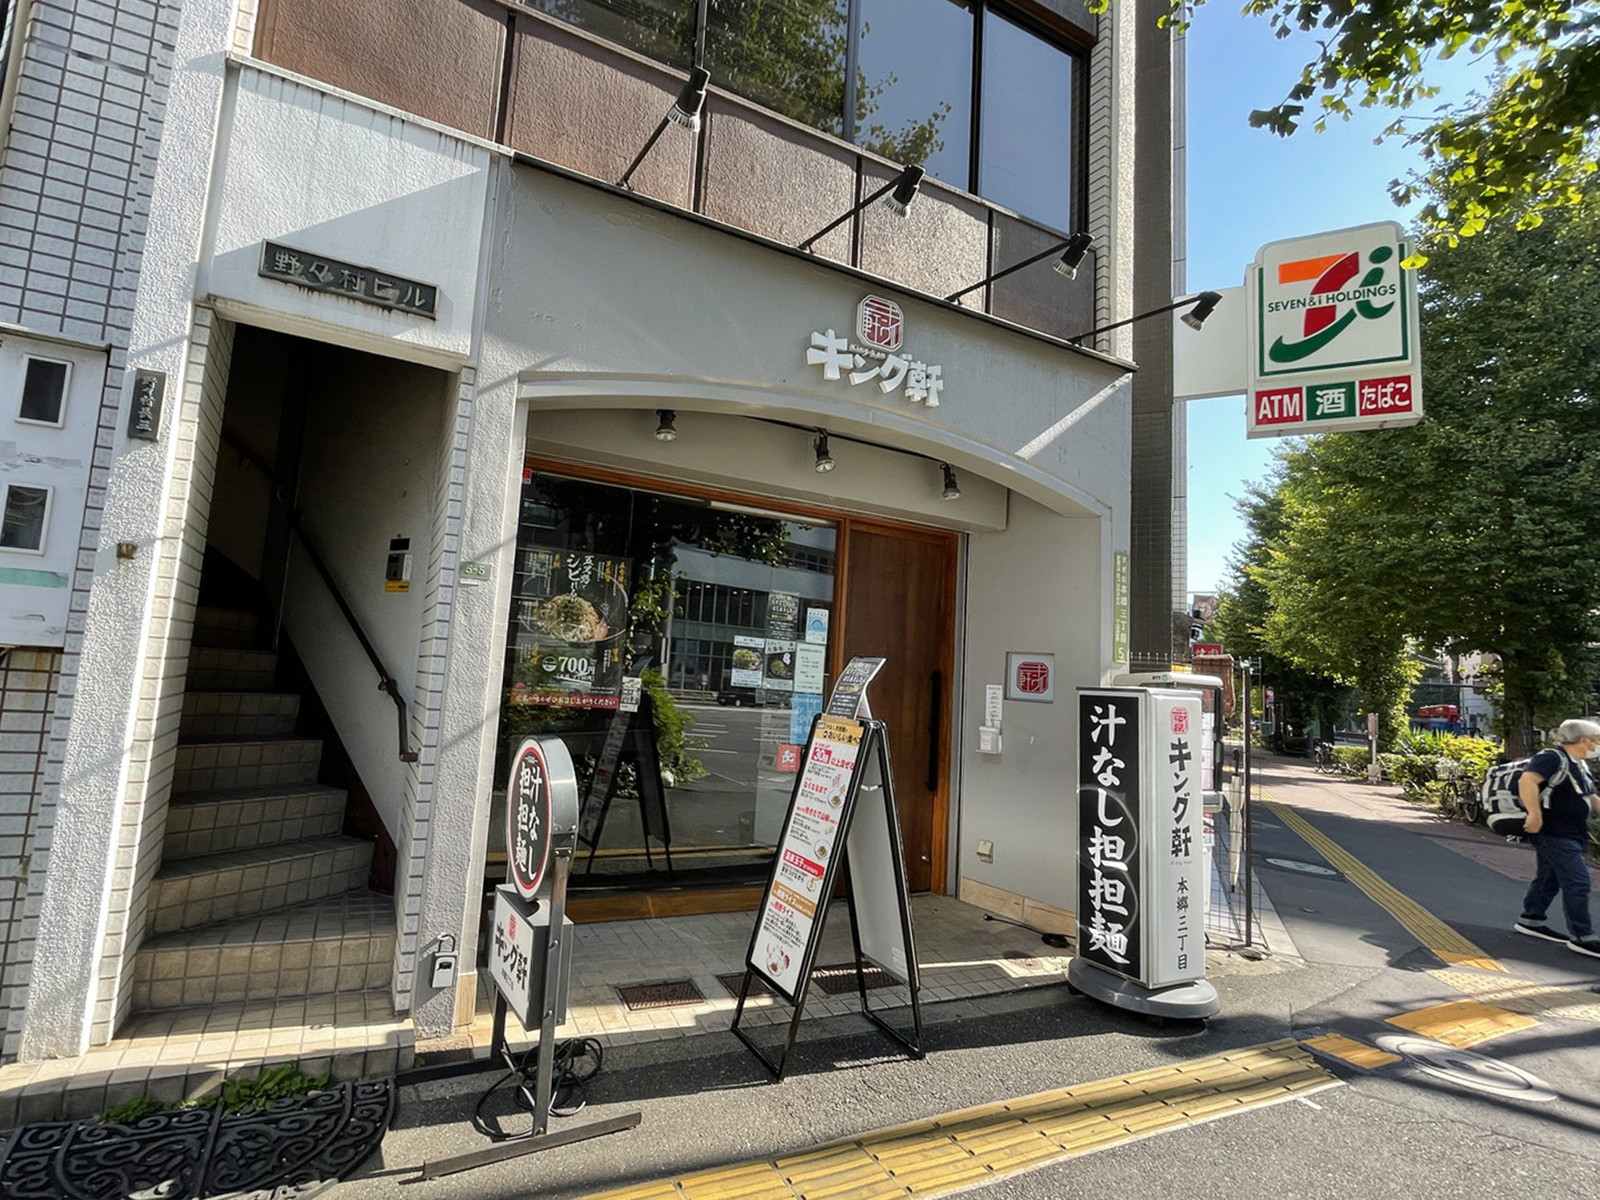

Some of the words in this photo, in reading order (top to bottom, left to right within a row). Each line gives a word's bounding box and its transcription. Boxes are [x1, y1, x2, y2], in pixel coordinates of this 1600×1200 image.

[274, 250, 426, 307] 野々村ビル
[1325, 283, 1397, 305] HOLDINGS
[806, 328, 945, 408] キング軒
[1315, 387, 1346, 416] 酒
[1361, 382, 1410, 411] たばこ
[1258, 392, 1301, 420] ATM
[1118, 646, 1125, 660] 5
[514, 761, 532, 872] 担担麺
[528, 766, 543, 881] 汁なし
[1168, 736, 1193, 858] キング軒
[1087, 703, 1131, 965] 汁なし担担麺
[495, 921, 528, 992] キング軒
[1176, 875, 1189, 970] 本郷三丁目
